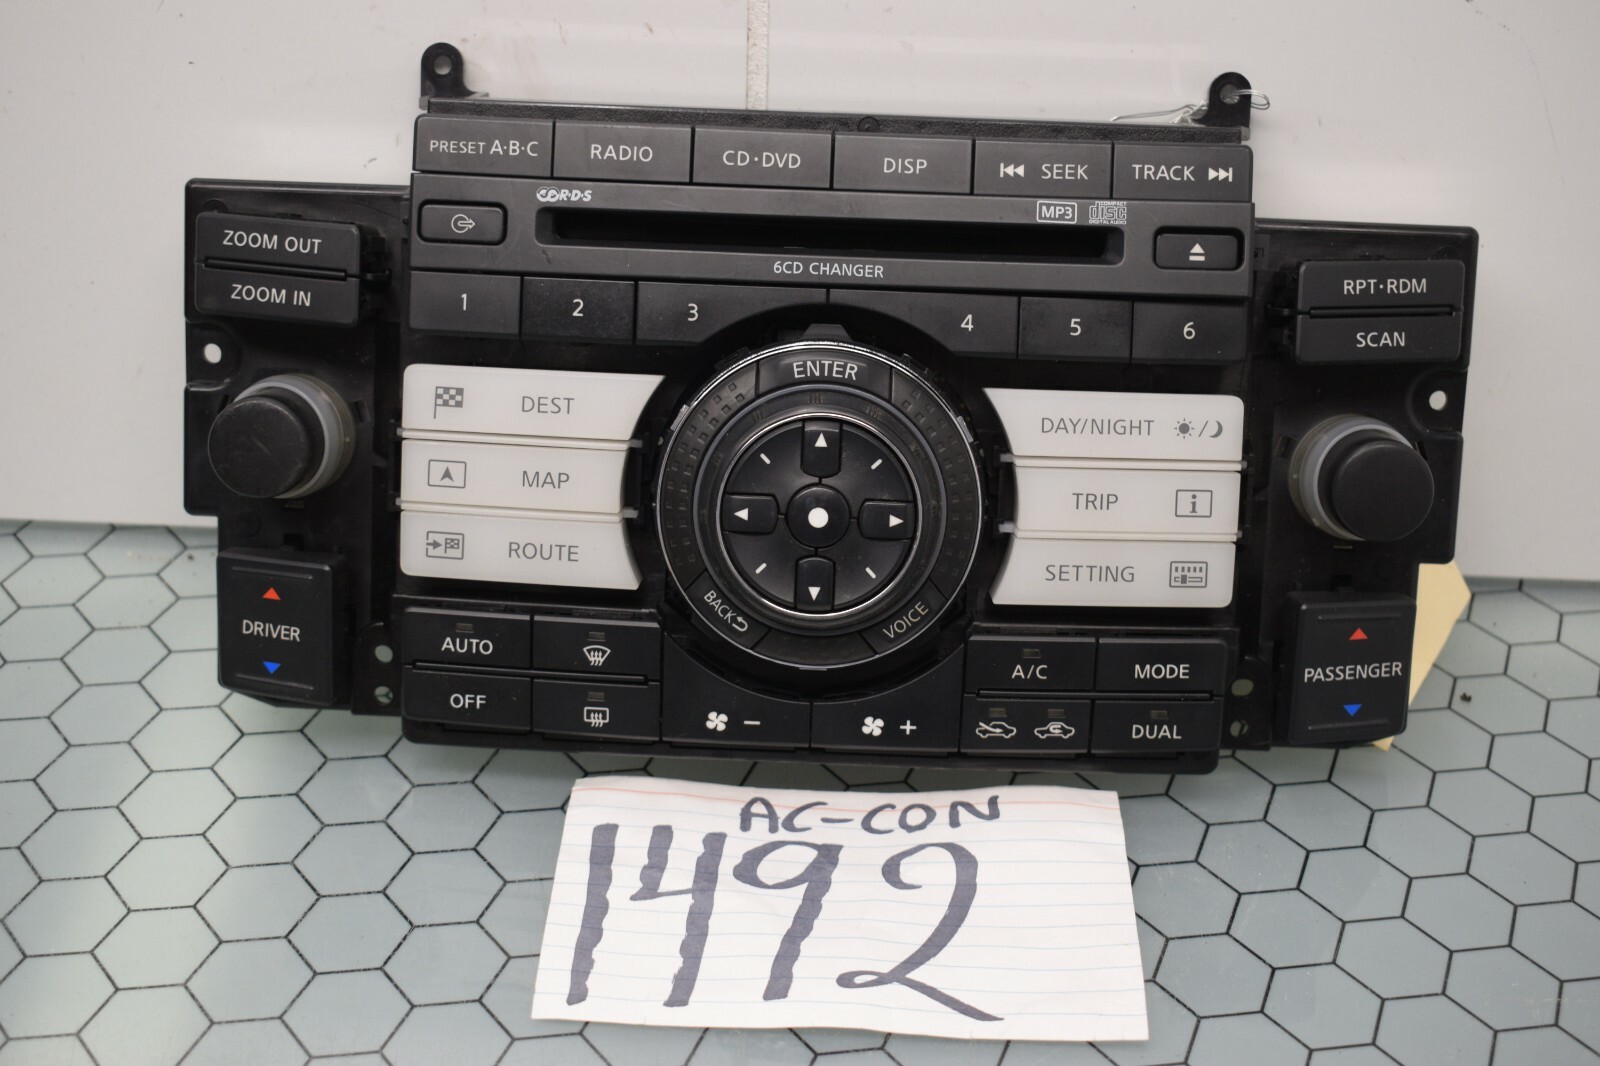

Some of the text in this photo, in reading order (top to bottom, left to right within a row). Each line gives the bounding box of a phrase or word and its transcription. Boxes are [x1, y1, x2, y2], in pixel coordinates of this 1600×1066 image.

[430, 141, 485, 153] PRESET
[591, 144, 652, 161] RADIO
[884, 158, 927, 174] DISP
[1042, 164, 1088, 179] SEEK
[1132, 165, 1194, 180] TRACK
[1041, 205, 1073, 220] MP3
[223, 230, 321, 253] ZOOM OUT
[774, 261, 883, 277] 6CD CHANGER
[231, 284, 310, 306] ZOOM IN
[460, 293, 467, 311] 1
[573, 299, 583, 316] 2
[688, 304, 698, 321] 3
[961, 314, 973, 331] 4
[1071, 319, 1081, 335] 5
[1184, 322, 1195, 339] 6
[1357, 332, 1404, 347] SCAN
[792, 360, 858, 382] ENTER
[522, 396, 574, 414] DEST
[1042, 418, 1154, 435] DAY/NIGHT
[523, 471, 569, 488] MAP
[1073, 493, 1118, 510] TRIP
[509, 542, 578, 561] ROUTE
[1046, 565, 1134, 582] SETTING
[703, 590, 736, 624] BACK
[883, 602, 929, 640] VOICE
[243, 620, 300, 641] DRIVER
[442, 637, 493, 654] AUTO
[1012, 665, 1047, 679] A/C
[1135, 664, 1189, 678] MODE
[1305, 662, 1401, 682] PASSENGER
[450, 694, 486, 708] OFF
[1132, 725, 1181, 739] DUAL
[740, 795, 1000, 834] AC-CON
[565, 823, 1004, 1022] 1492
